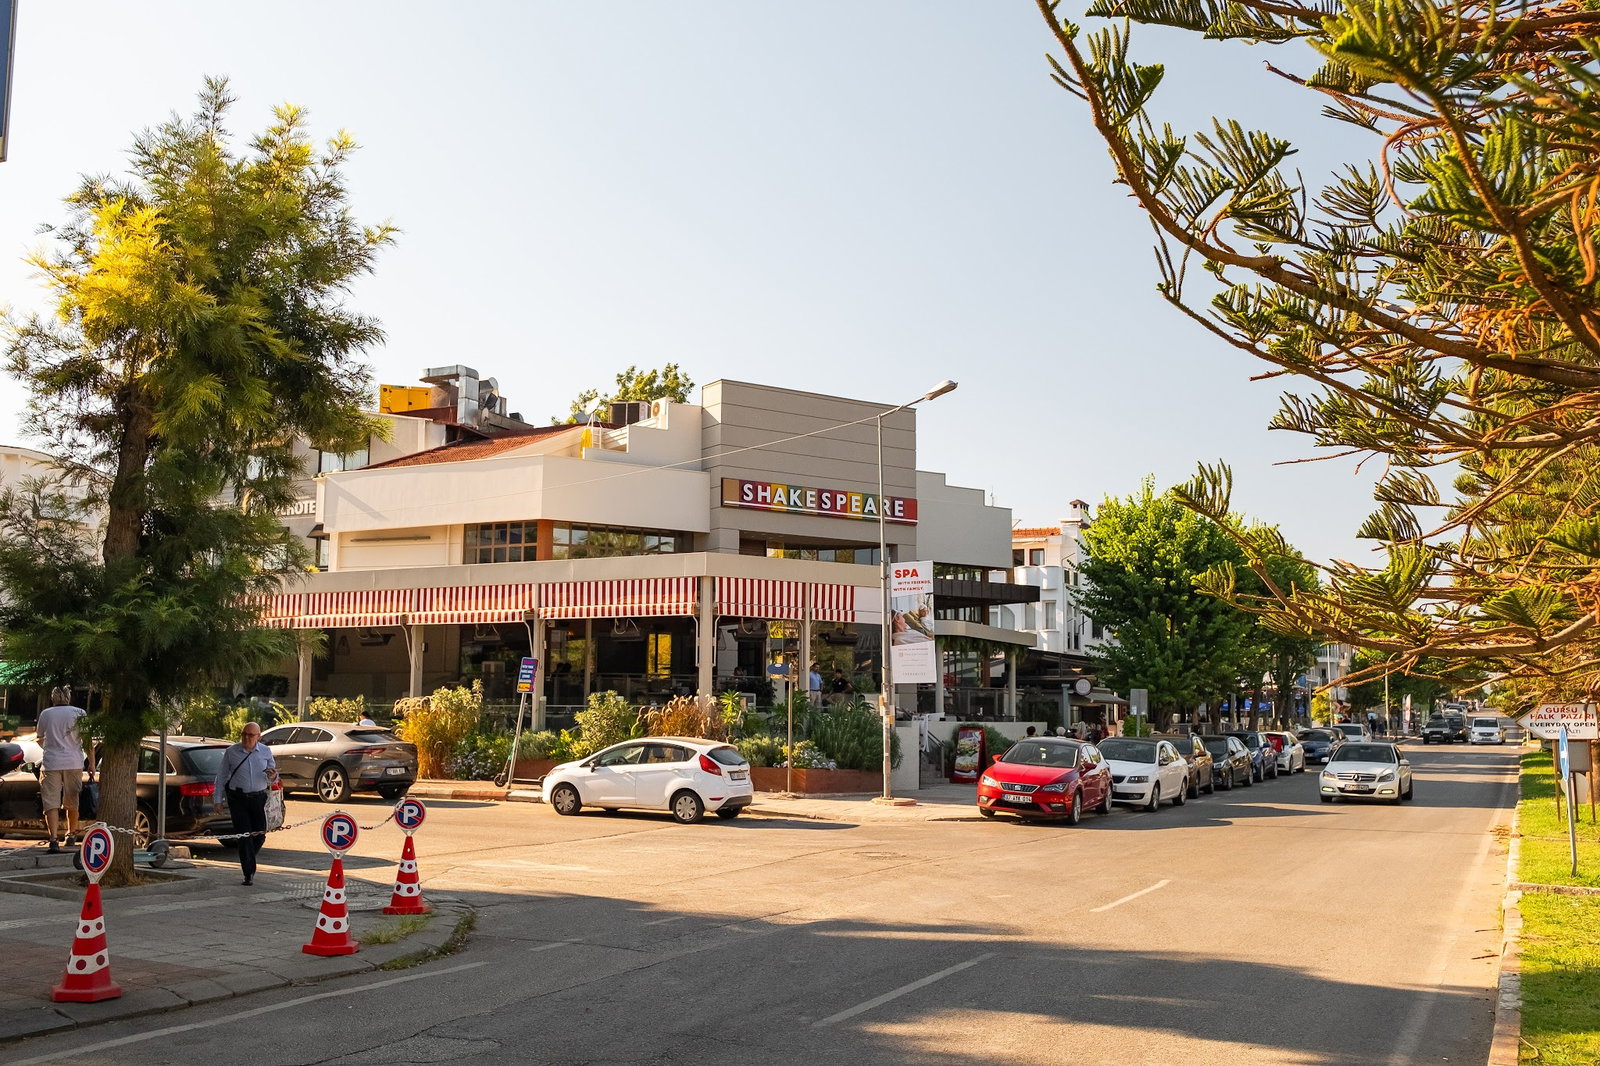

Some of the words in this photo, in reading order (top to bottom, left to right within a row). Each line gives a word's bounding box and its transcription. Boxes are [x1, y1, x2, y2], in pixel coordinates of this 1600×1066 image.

[743, 483, 904, 517] SHAKESPEARE
[894, 568, 918, 578] SPA
[402, 805, 419, 824] P
[331, 821, 350, 843] P
[89, 837, 106, 864] P
